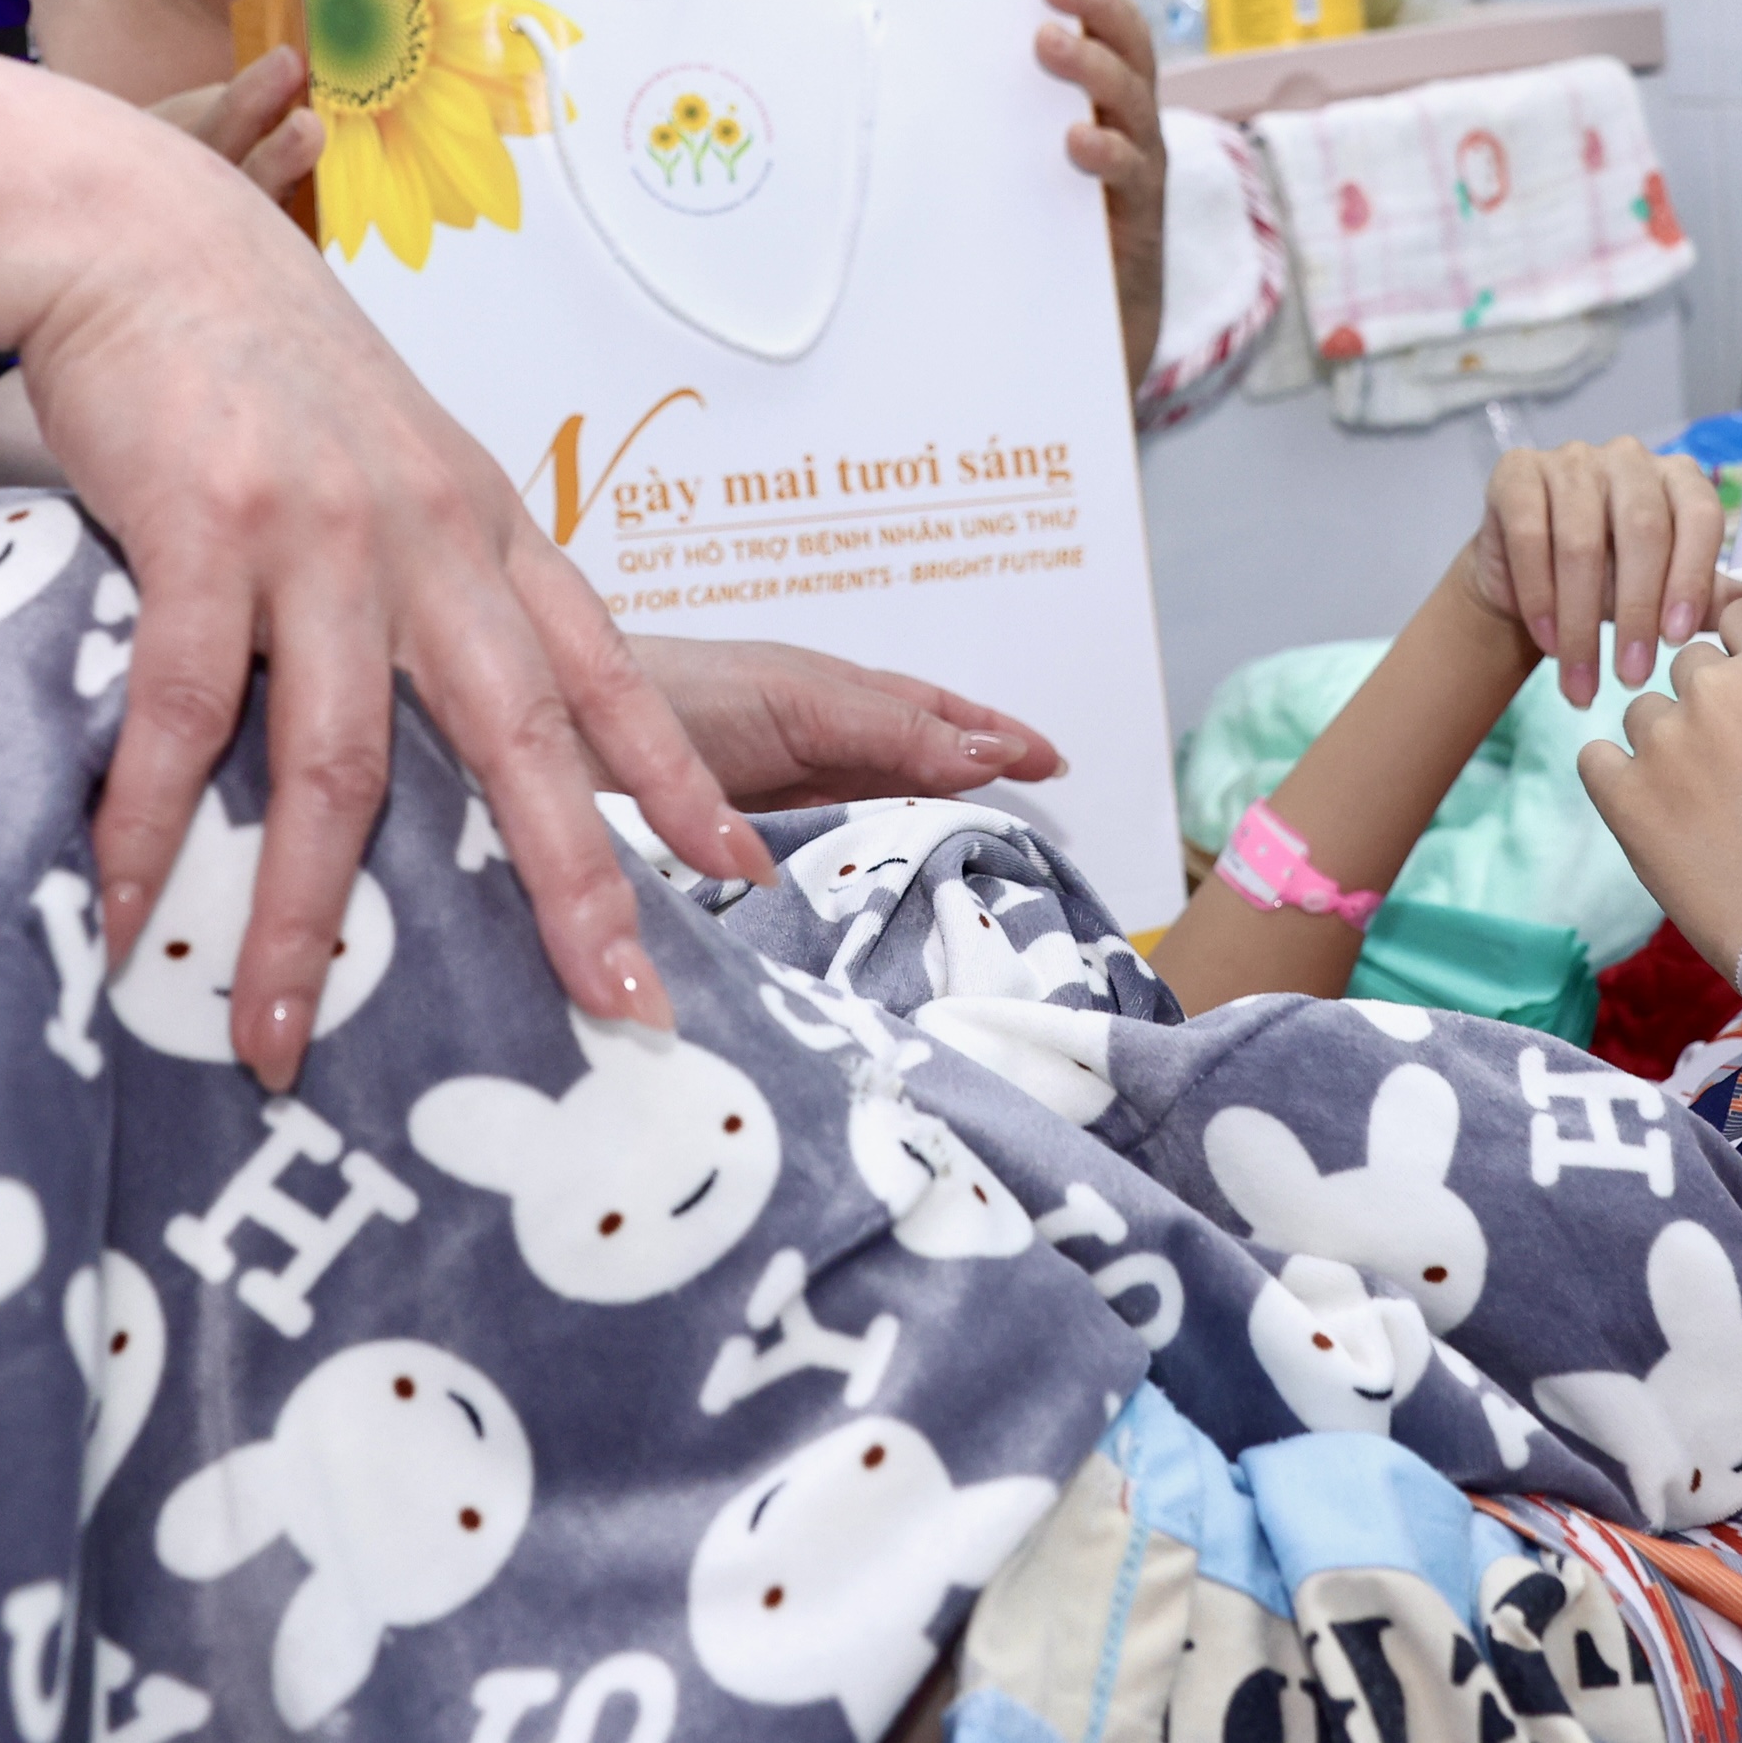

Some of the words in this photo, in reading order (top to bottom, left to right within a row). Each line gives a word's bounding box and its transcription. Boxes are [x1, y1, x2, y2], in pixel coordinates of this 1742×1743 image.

[724, 452, 818, 507] mai
[836, 441, 941, 495] tươi
[958, 433, 1073, 489] sáng
[878, 516, 954, 548] NHÂN
[632, 587, 679, 613] FOR
[685, 575, 780, 608] CANCER
[785, 563, 892, 596] PATIENTS
[910, 554, 994, 584] BRIGHT
[998, 544, 1085, 574] FUTURE
